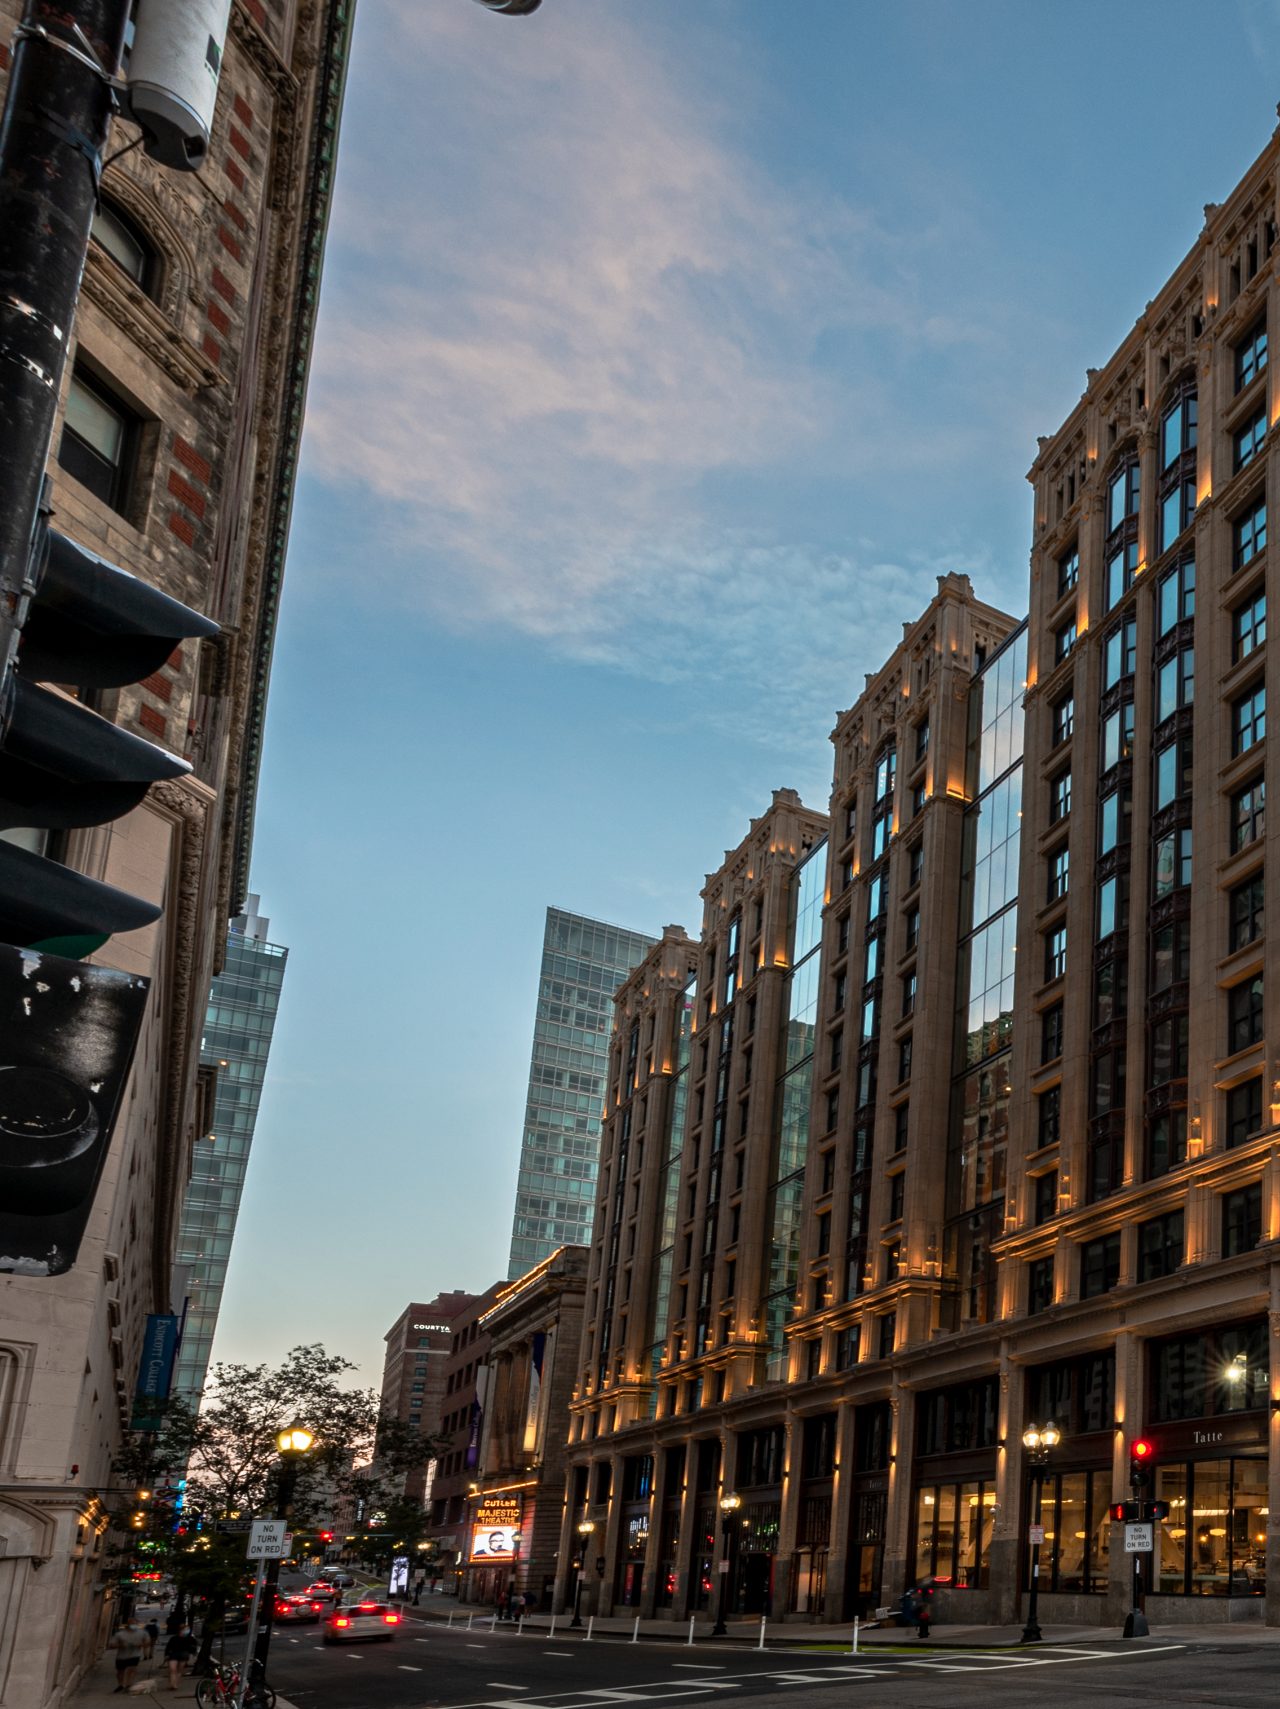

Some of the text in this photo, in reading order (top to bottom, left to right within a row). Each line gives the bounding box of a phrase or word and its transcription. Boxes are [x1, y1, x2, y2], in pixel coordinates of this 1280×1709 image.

[1193, 1431, 1223, 1444] Tatte
[477, 1508, 520, 1517] MAJESTIC
[263, 1524, 274, 1532] NO
[257, 1535, 278, 1543] TURN
[1130, 1533, 1147, 1541] TURN
[250, 1545, 281, 1554] ON RED
